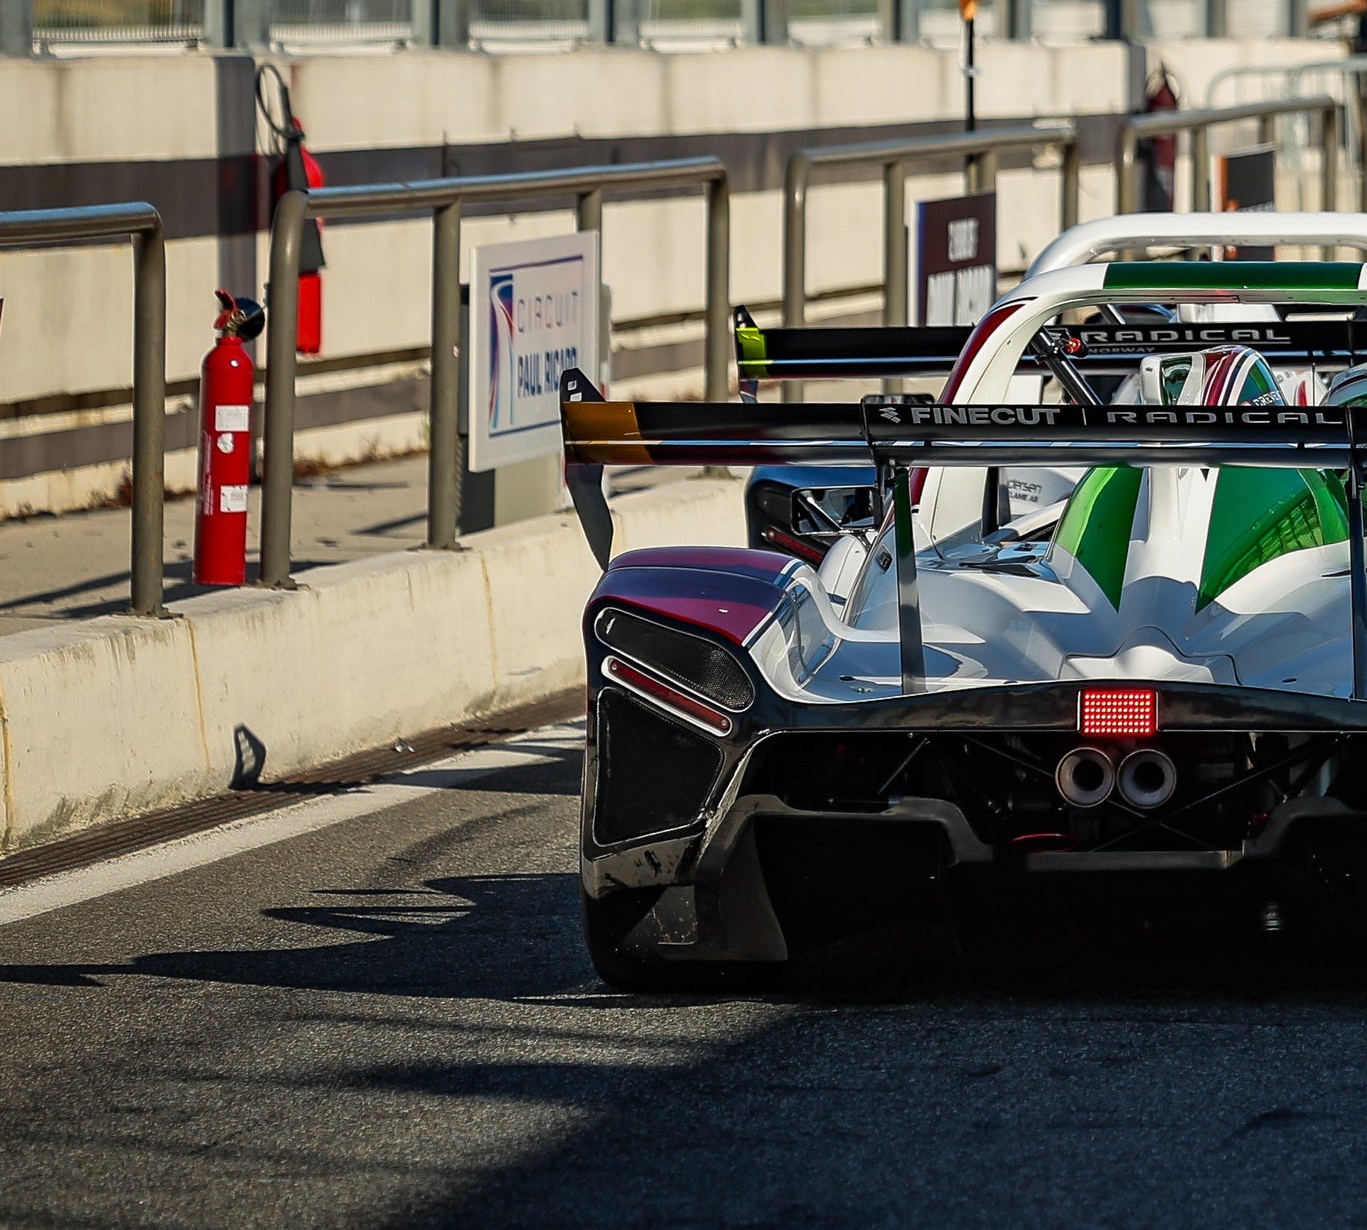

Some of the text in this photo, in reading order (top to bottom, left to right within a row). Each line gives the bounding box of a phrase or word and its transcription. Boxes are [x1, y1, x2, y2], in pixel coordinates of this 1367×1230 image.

[516, 290, 579, 334] CIRCUIT
[1080, 328, 1291, 343] RADICAL
[517, 352, 542, 399] PAUL
[910, 406, 1343, 425] FINECUT RADICAL
